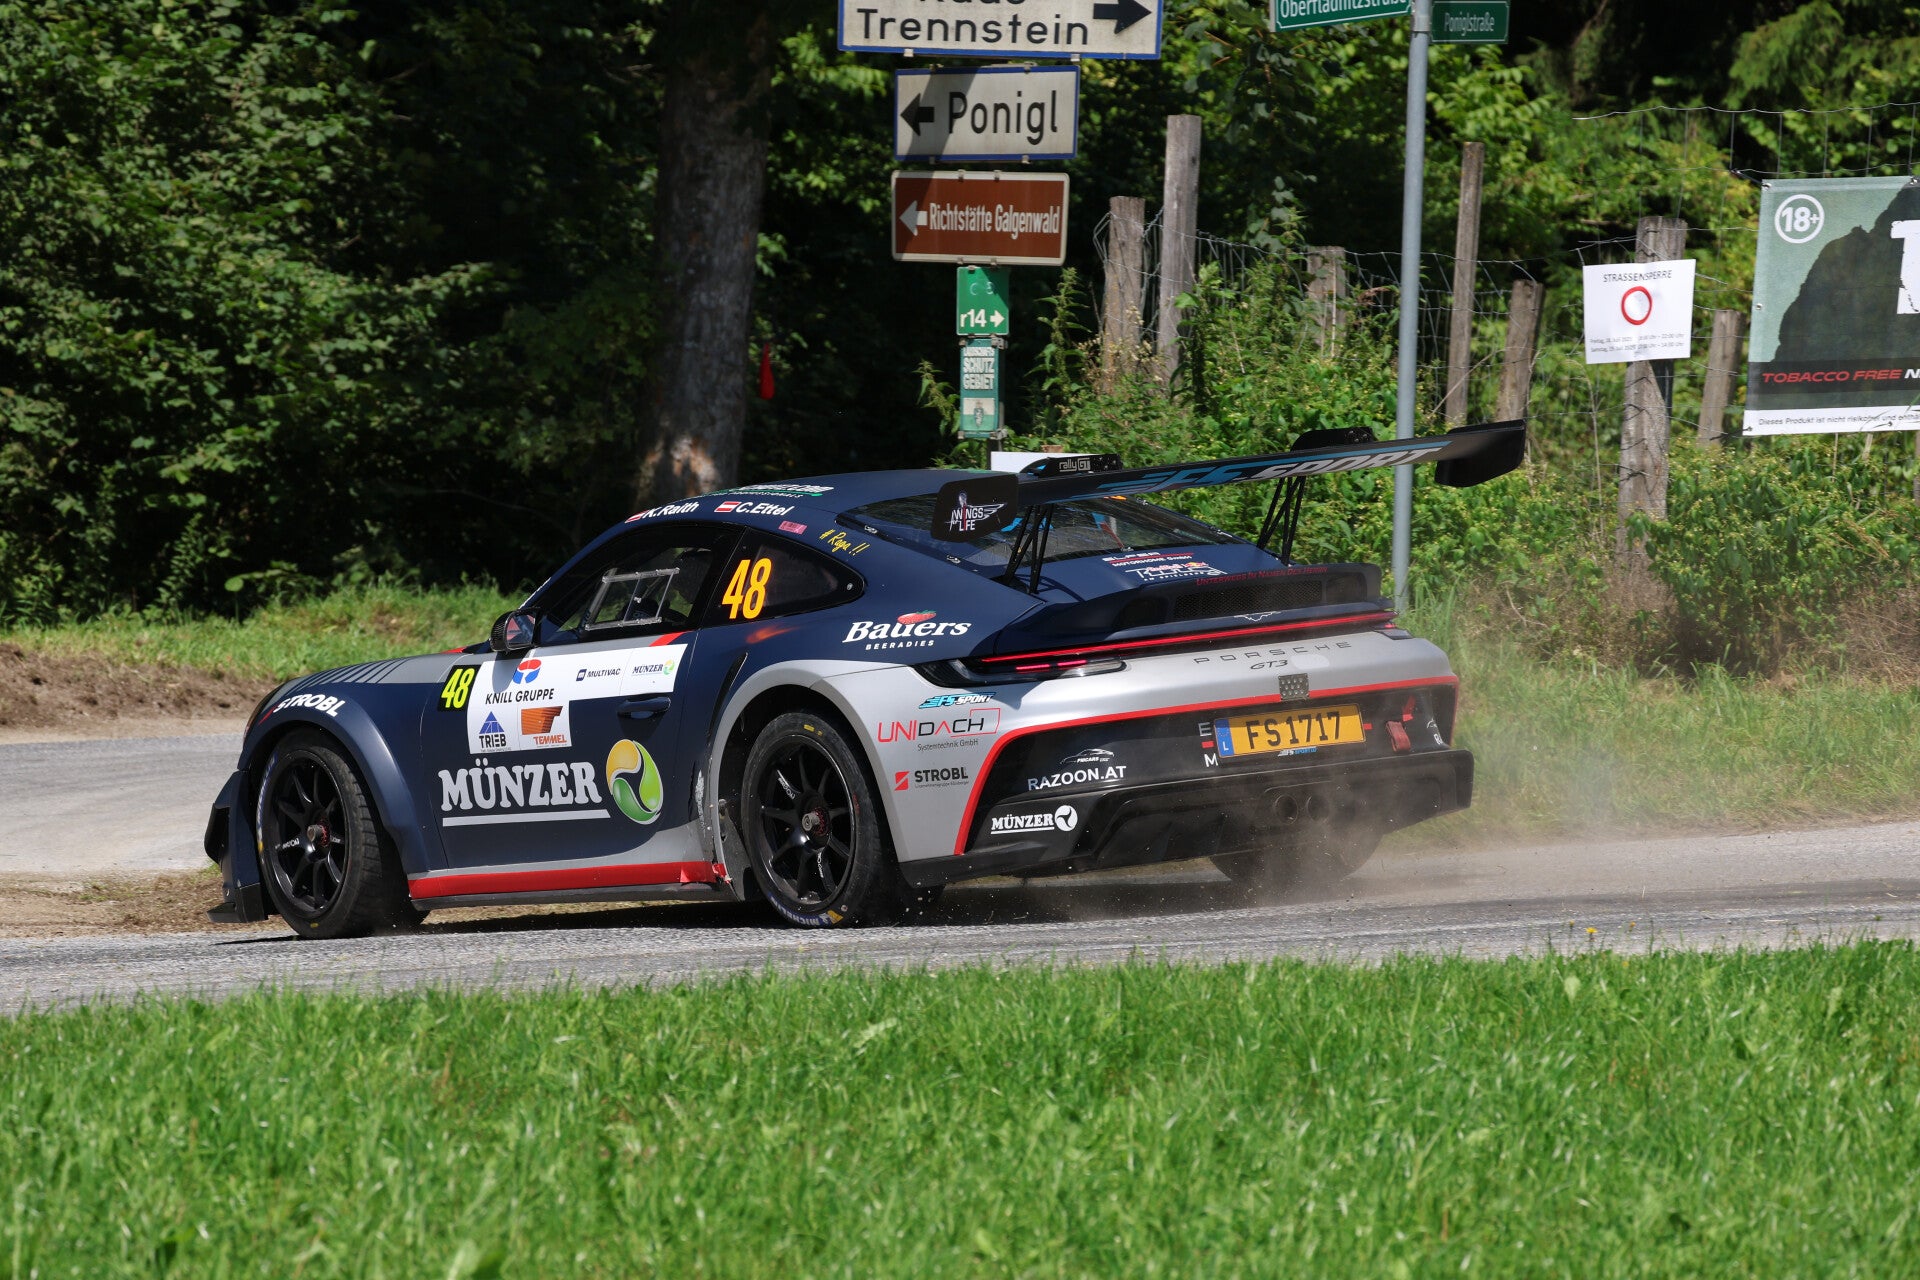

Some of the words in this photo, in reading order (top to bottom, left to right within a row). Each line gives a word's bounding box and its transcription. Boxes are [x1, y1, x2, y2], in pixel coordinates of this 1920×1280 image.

[1280, 0, 1407, 18] Oberfladnitzs
[857, 8, 1088, 45] Trennstein
[1444, 11, 1495, 36] Poniglstraße
[948, 90, 1058, 145] Ponigl
[929, 202, 992, 232] Richtstätte
[994, 204, 1060, 240] Galgenwald
[1780, 207, 1820, 232] 18+
[1602, 269, 1673, 283] STRASSENSPERRE
[960, 308, 987, 328] r14
[963, 357, 995, 373] SCHUTZ
[963, 374, 995, 390] GEBIET
[1762, 371, 1850, 383] TOBACCO
[1853, 369, 1903, 381] FREE
[1785, 416, 1814, 424] Produkt
[1816, 416, 1825, 424] ist
[1827, 415, 1845, 423] nicht
[1059, 457, 1077, 472] rally
[642, 501, 700, 518] K.Raith
[735, 502, 796, 517] C.Ettel
[953, 508, 984, 520] WINGS
[959, 519, 976, 532] LIFE
[721, 557, 773, 620] 48
[842, 620, 973, 643] Bauers
[865, 640, 935, 651] BEERADIES
[1193, 641, 1352, 665] PORSCHE
[586, 668, 621, 678] MULTIVAC
[632, 663, 664, 674] MÜNZER
[1250, 659, 1289, 670] GT3
[440, 667, 476, 709] 48
[485, 691, 513, 705] KNILL
[515, 688, 555, 702] GRUPPE
[273, 693, 346, 718] STROBL
[955, 693, 993, 705] SPORT
[877, 717, 985, 743] UNIDACH
[1245, 710, 1340, 750] FS1717
[479, 734, 507, 749] TRIEB
[533, 734, 568, 745] TEMMEL
[917, 740, 959, 752] Systemtechnik
[960, 738, 979, 748] GmbH
[1222, 741, 1229, 751] L
[914, 766, 969, 783] STROBL
[1027, 765, 1127, 791] RAZOON.AT
[438, 757, 603, 812] MÜNZER
[991, 812, 1054, 831] MÜNZER
